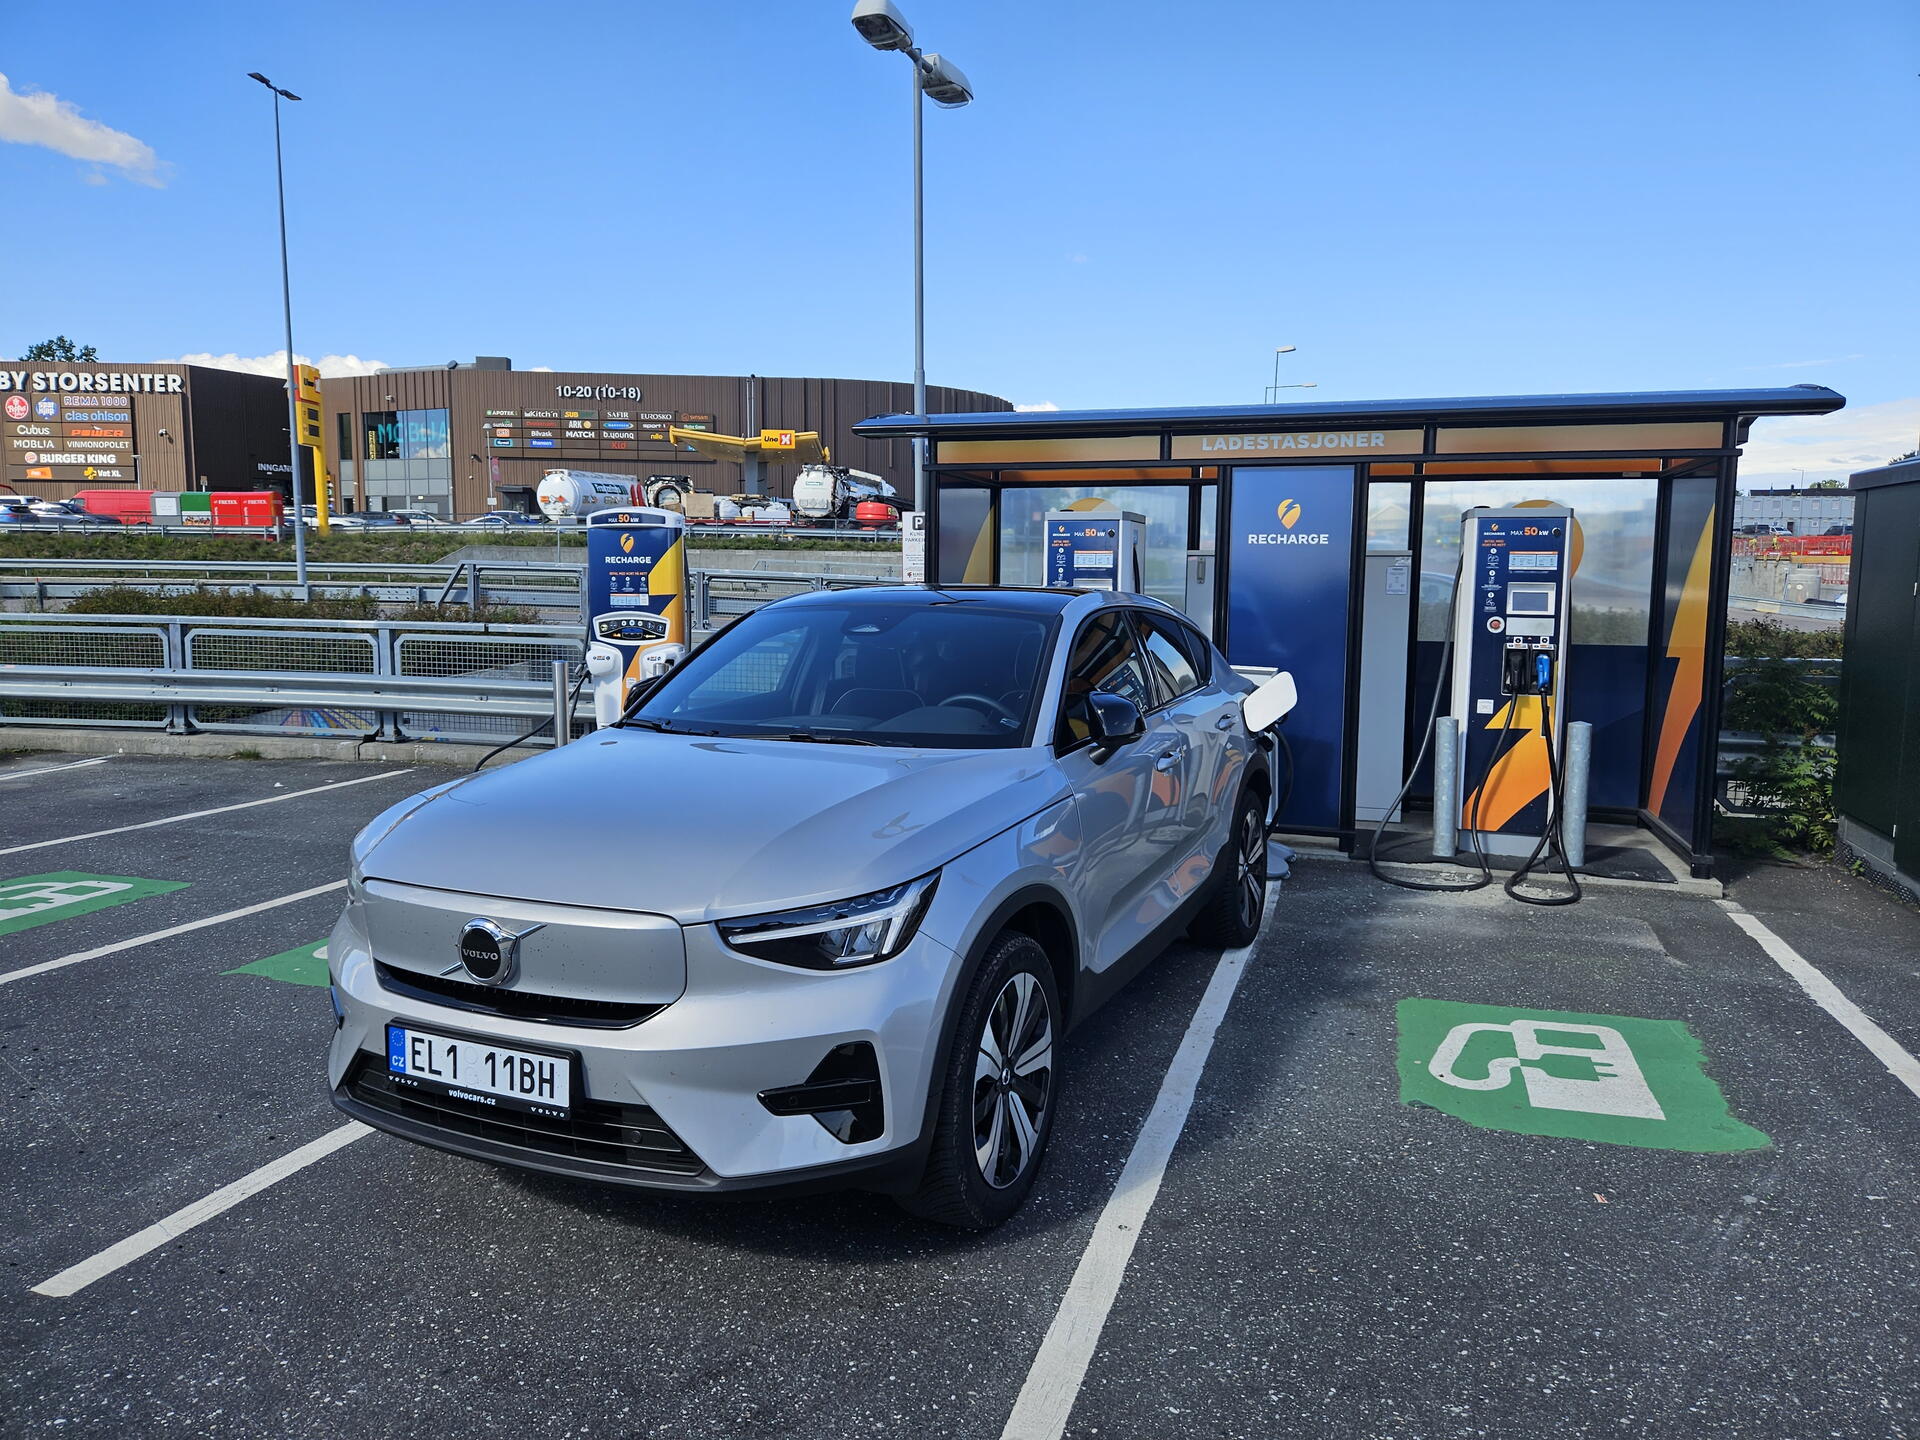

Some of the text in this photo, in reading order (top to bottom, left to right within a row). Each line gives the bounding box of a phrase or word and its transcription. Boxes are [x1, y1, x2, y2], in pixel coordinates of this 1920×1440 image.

[0, 371, 184, 393] BY STORSENTER
[556, 385, 641, 402] 10-20 (10-18)
[63, 396, 128, 406] REMA 1000
[65, 411, 128, 421] clas ohlson
[16, 424, 51, 435] Cubus
[568, 420, 582, 428] ARK
[67, 441, 129, 449] VINMONOPOLET
[1202, 432, 1385, 451] LADESTASJONER
[39, 453, 86, 464] BURGER
[87, 453, 117, 464] KING
[618, 513, 630, 523] 50
[914, 517, 923, 529] P
[1085, 528, 1097, 537] 50
[1524, 526, 1538, 536] 50
[1248, 533, 1329, 545] RECHARGE
[605, 556, 652, 564] RECHARGE
[462, 949, 499, 961] VOLVO
[391, 1055, 405, 1068] CZ
[411, 1036, 555, 1099] EL1 11BH
[388, 1075, 419, 1087] VOLVO
[448, 1088, 496, 1106] volvocars.cz
[530, 1106, 566, 1118] VOLVO
